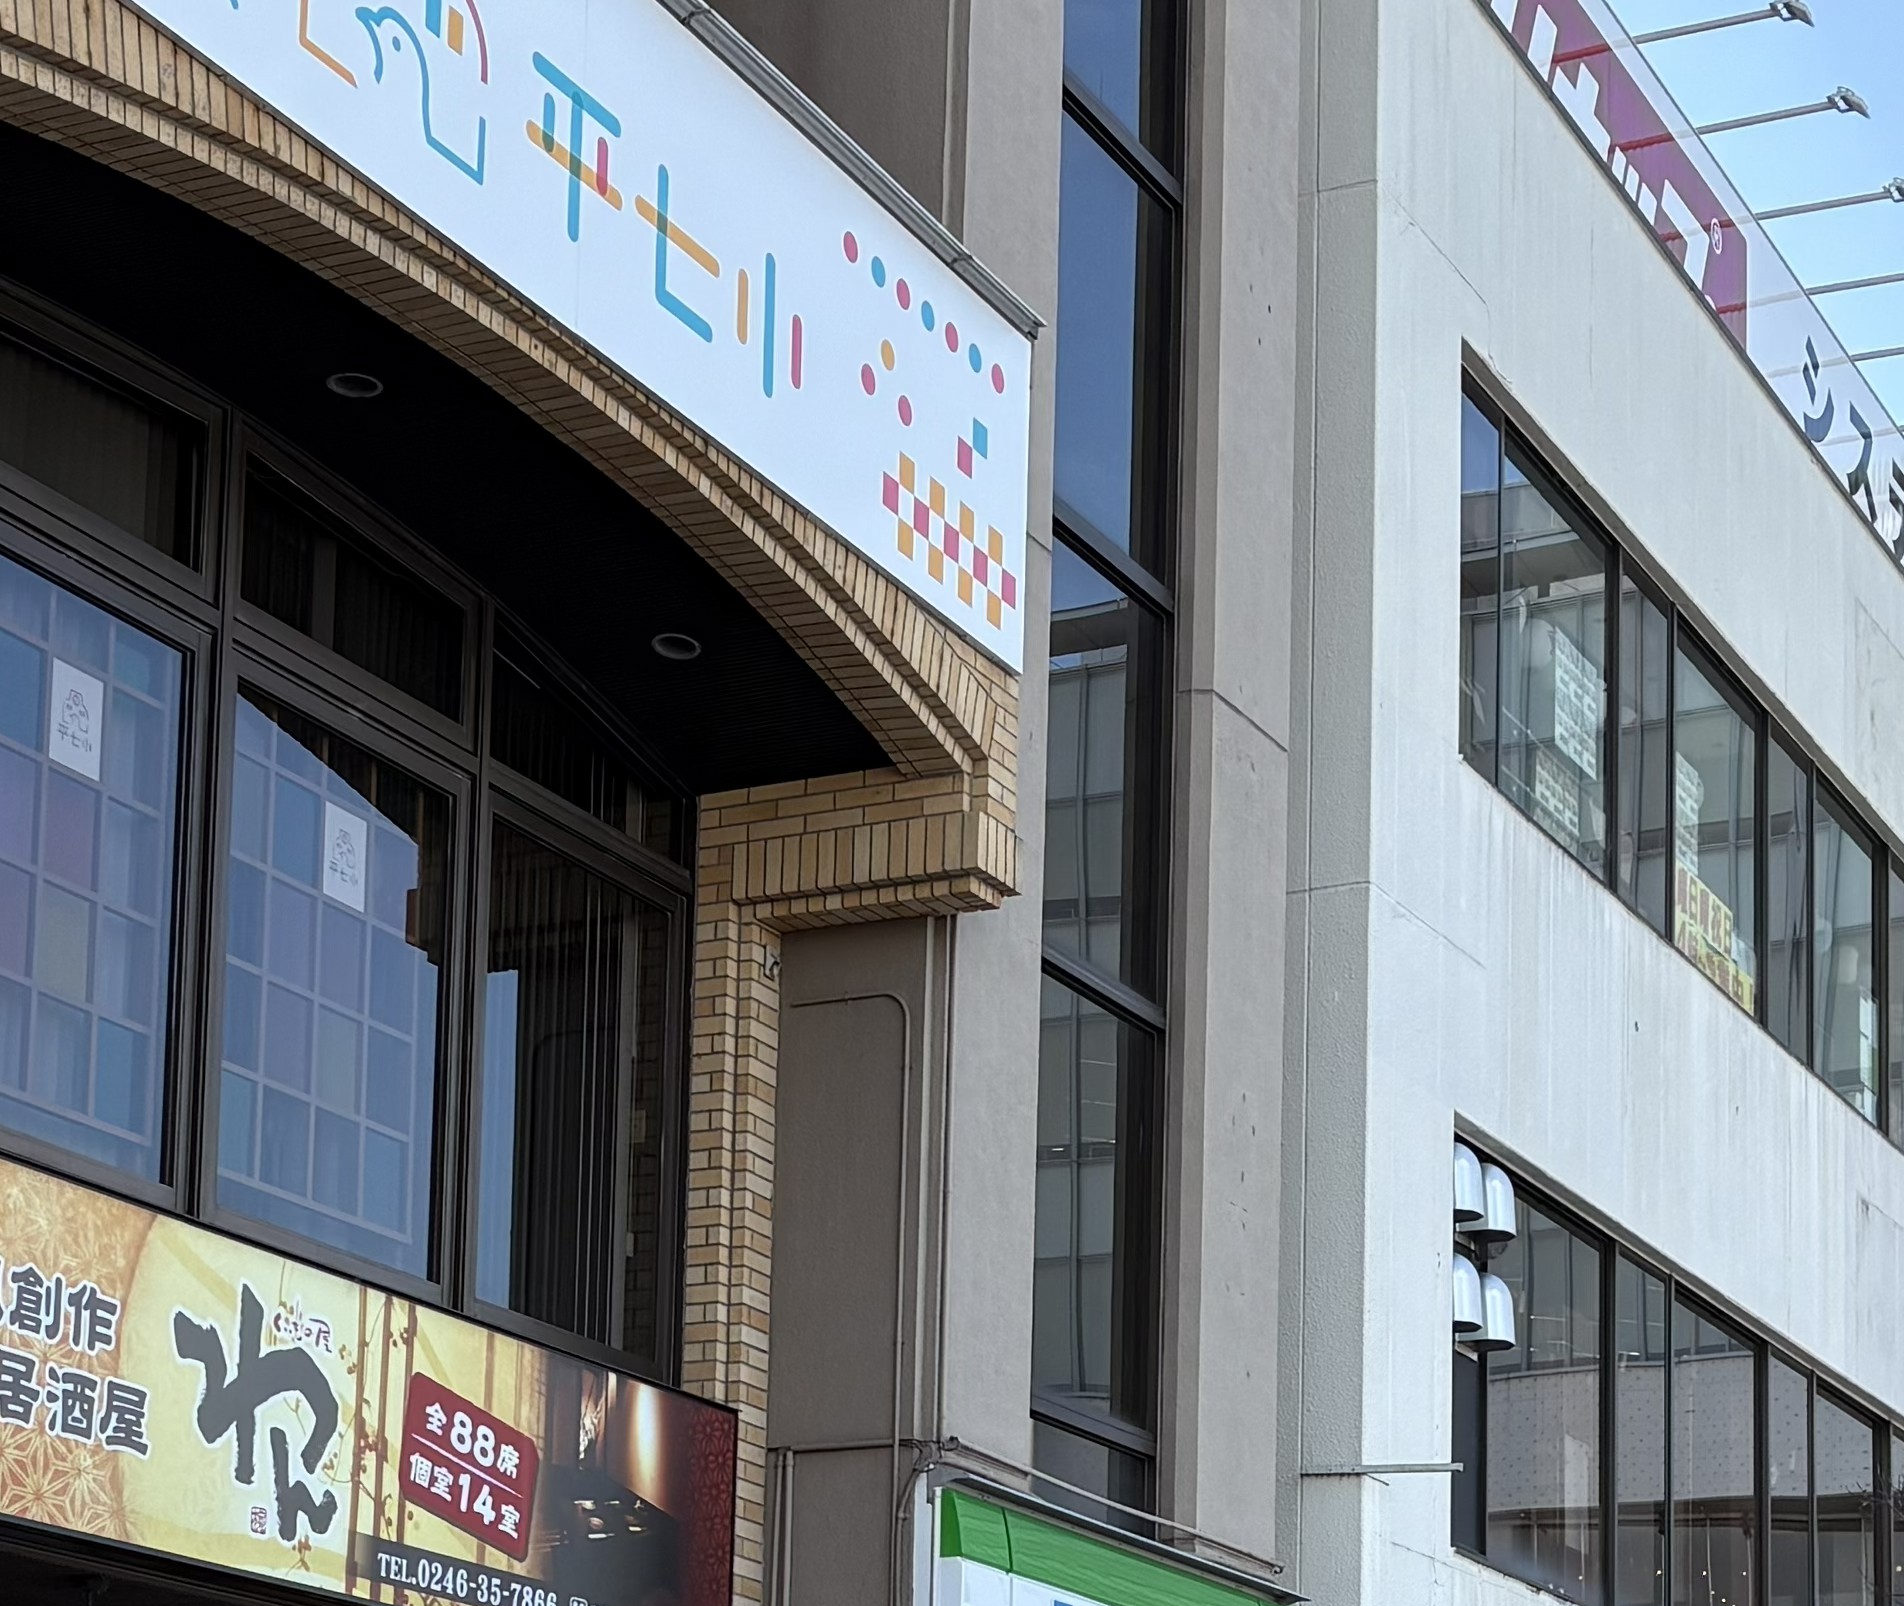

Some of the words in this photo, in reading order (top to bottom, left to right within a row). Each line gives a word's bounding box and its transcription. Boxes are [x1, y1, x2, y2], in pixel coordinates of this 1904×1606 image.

[173, 1279, 339, 1542] わん
[424, 1401, 521, 1480] 全88席
[408, 1451, 521, 1540] 個室14室
